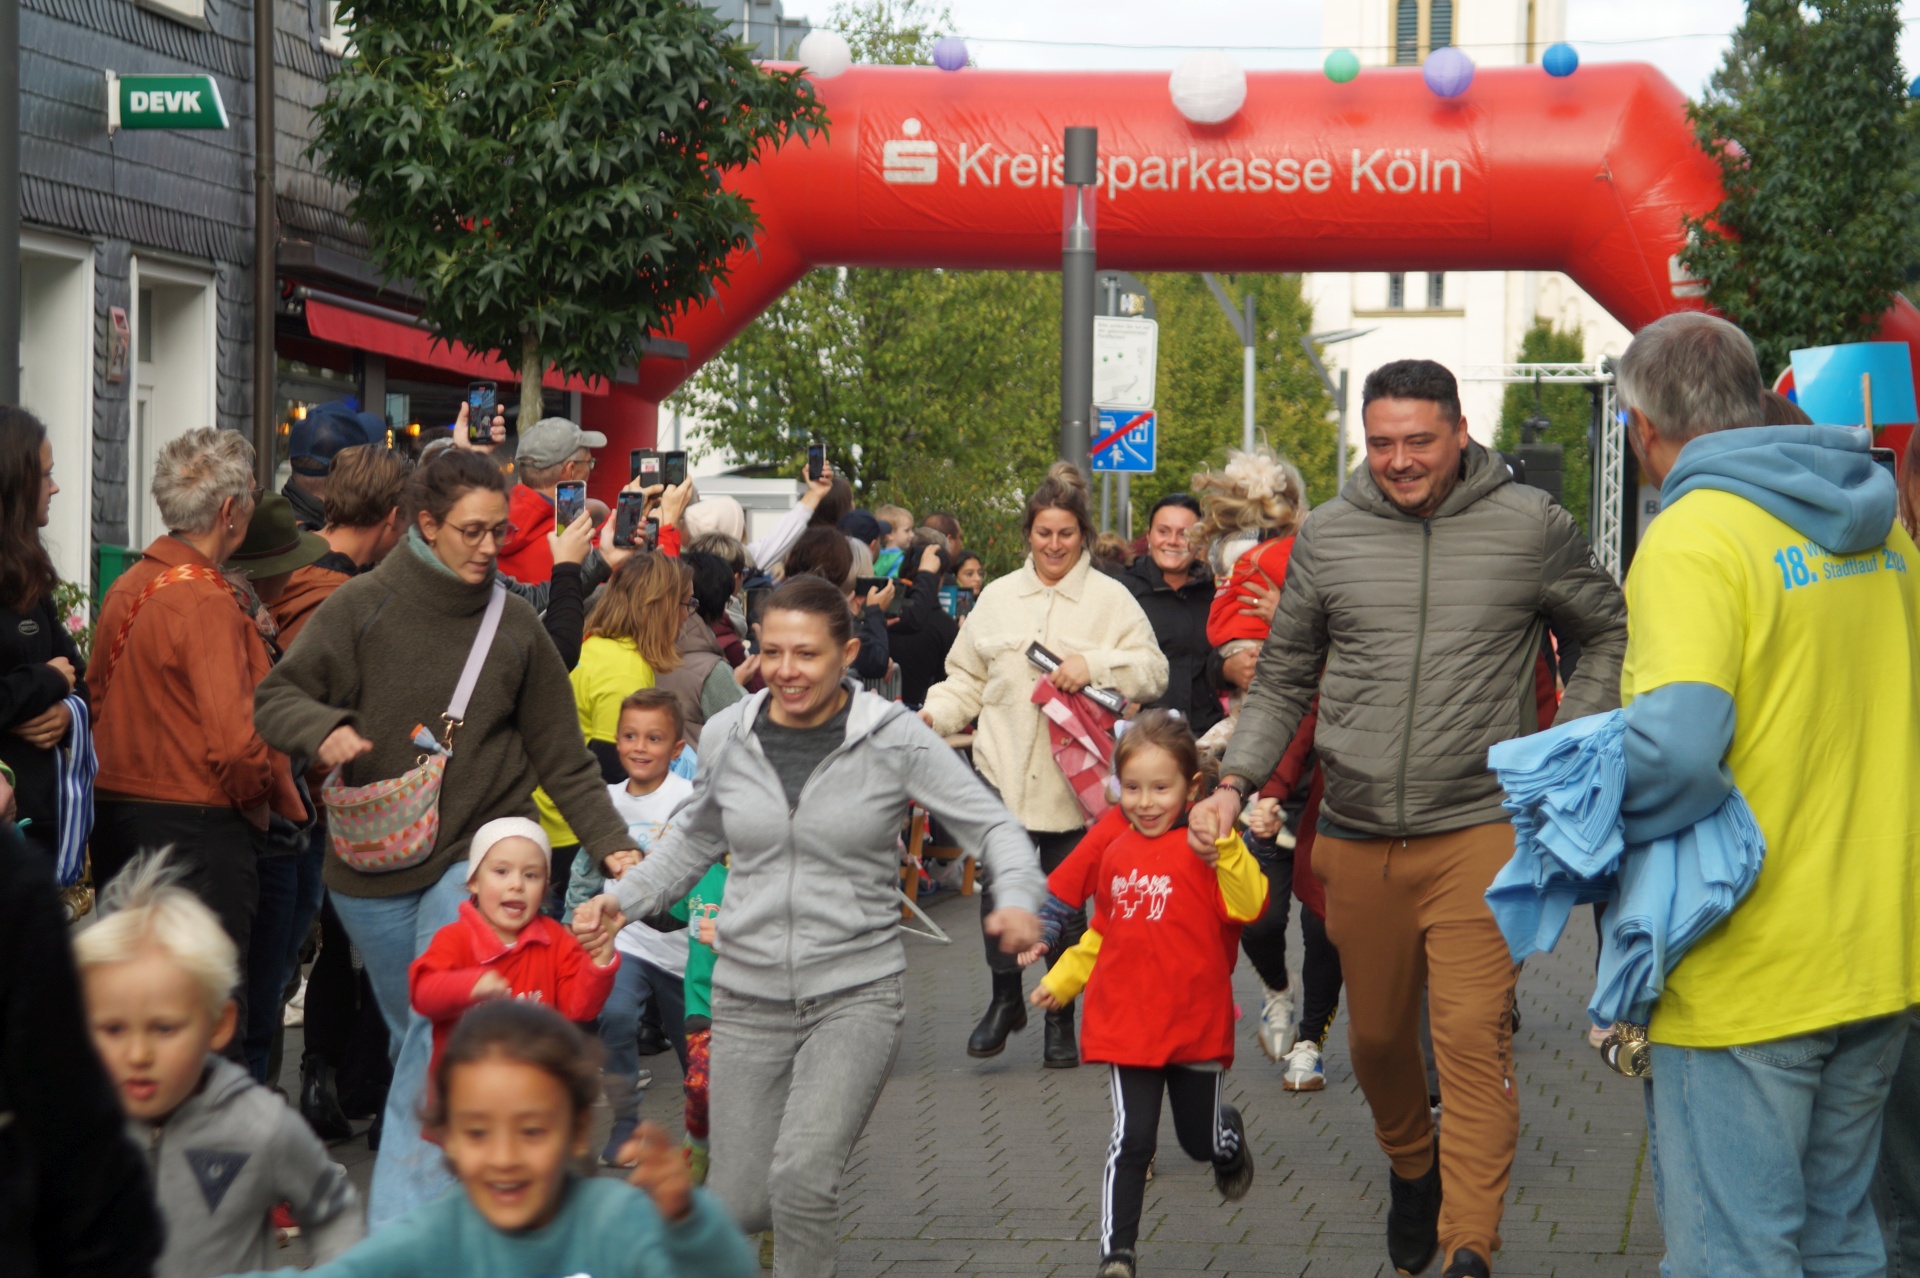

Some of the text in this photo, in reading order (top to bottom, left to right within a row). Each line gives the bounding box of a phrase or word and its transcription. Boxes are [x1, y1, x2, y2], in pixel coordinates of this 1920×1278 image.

[130, 90, 202, 113] DEVK
[957, 142, 1462, 200] Kreisparkasse Köln
[1774, 545, 1819, 590] 18.
[1823, 554, 1879, 579] Stadtlauf
